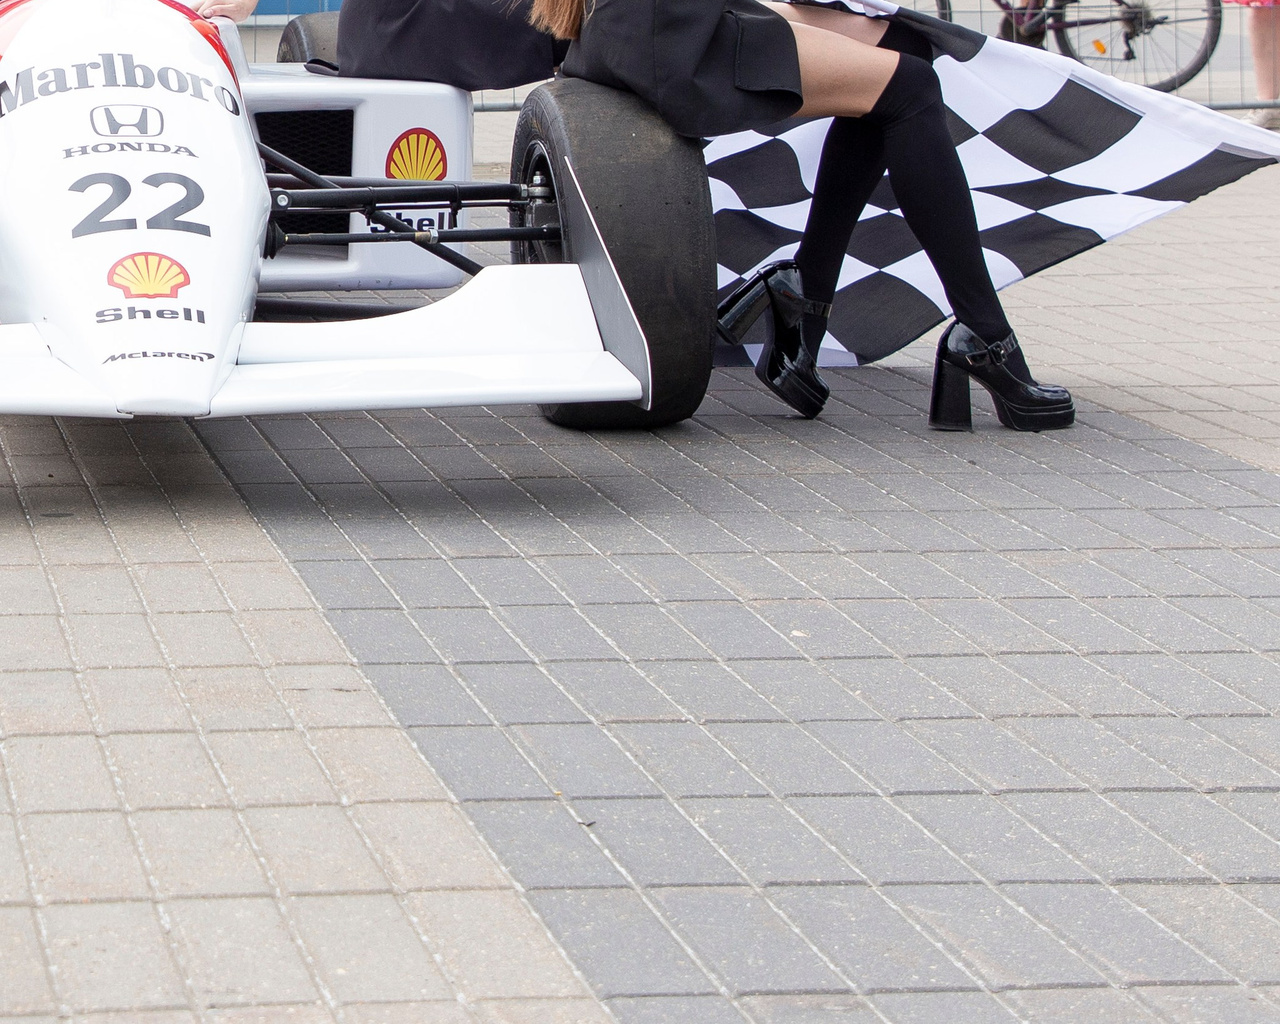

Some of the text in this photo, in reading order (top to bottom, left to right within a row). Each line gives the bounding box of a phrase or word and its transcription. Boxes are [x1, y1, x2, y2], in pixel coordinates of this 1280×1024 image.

[62, 142, 199, 159] HONDA
[68, 172, 211, 239] 22
[95, 306, 206, 324] Shell
